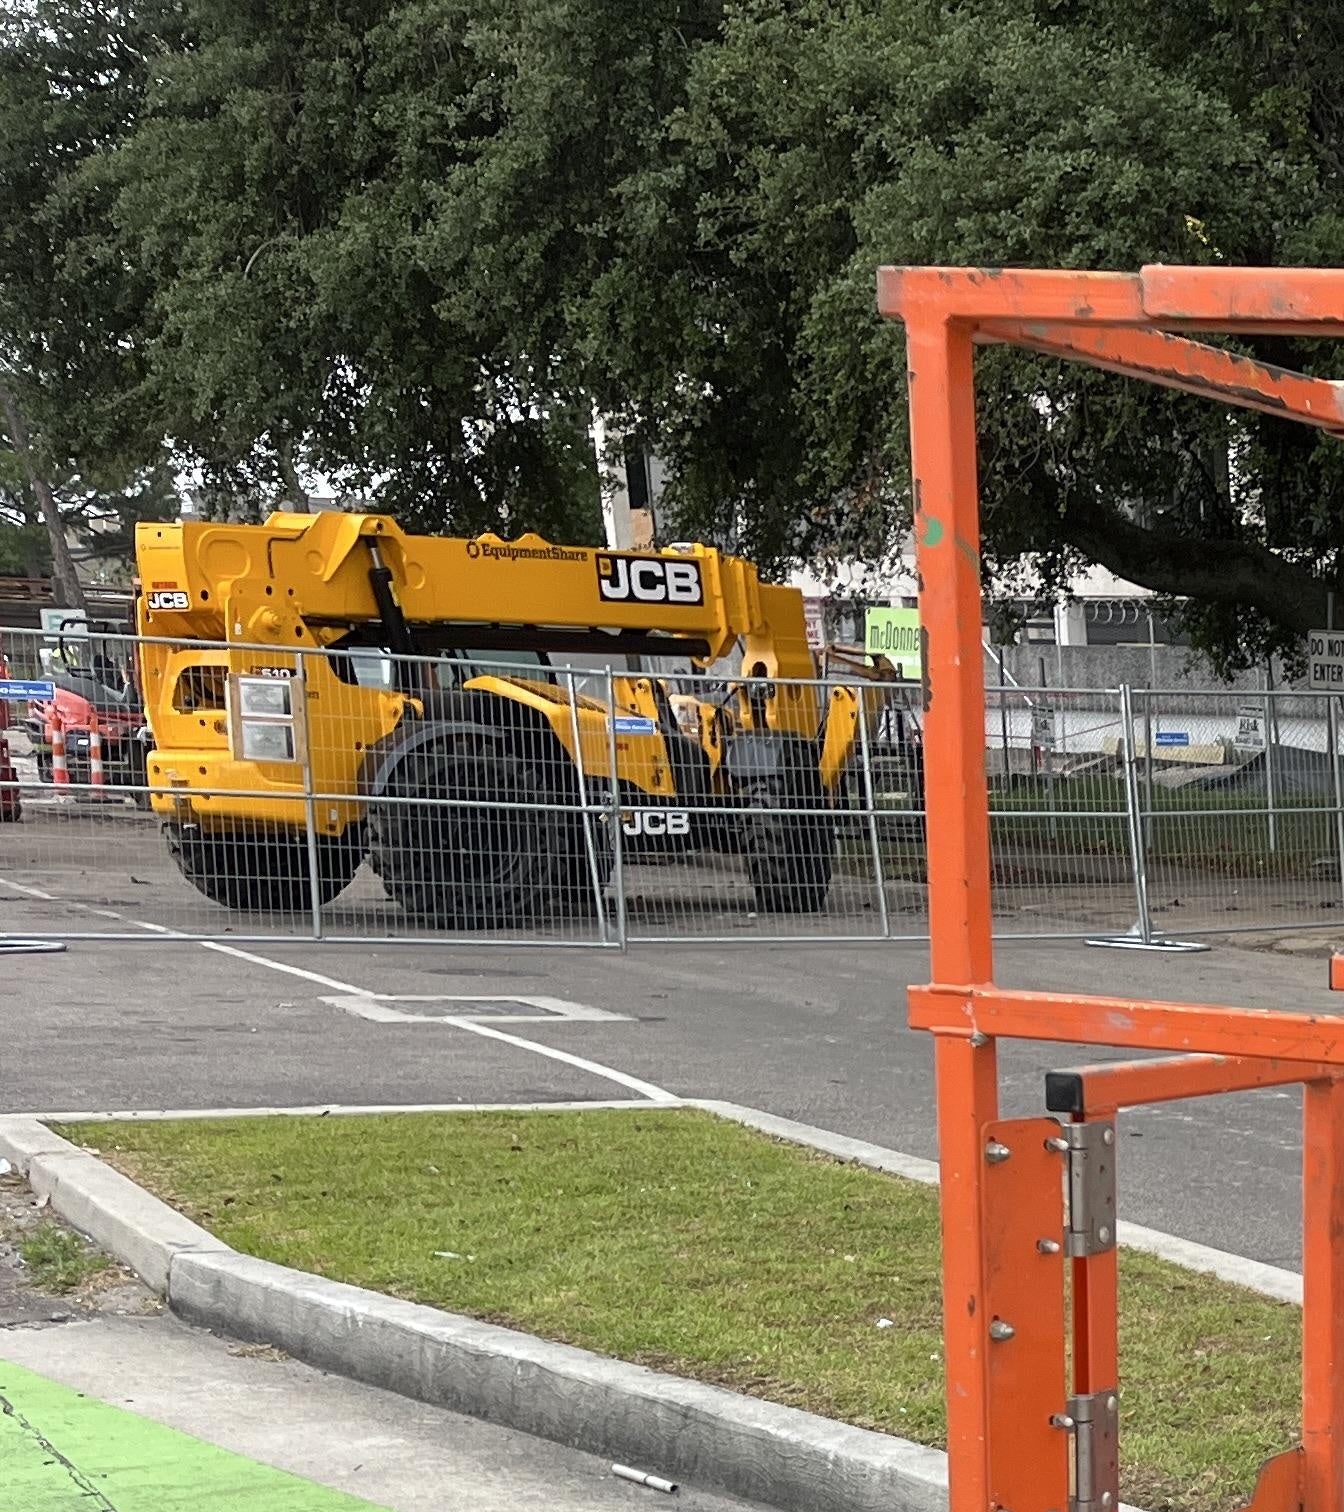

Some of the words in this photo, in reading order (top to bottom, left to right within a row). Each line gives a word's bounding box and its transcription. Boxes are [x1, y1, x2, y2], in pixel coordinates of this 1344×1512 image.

[481, 543, 588, 561] EquipmentShare
[600, 558, 701, 602] JCB
[148, 592, 189, 609] JCB
[870, 620, 920, 652] mcDonne
[1311, 638, 1324, 656] DO
[1313, 663, 1344, 682] ENTER
[622, 811, 690, 835] JCB
